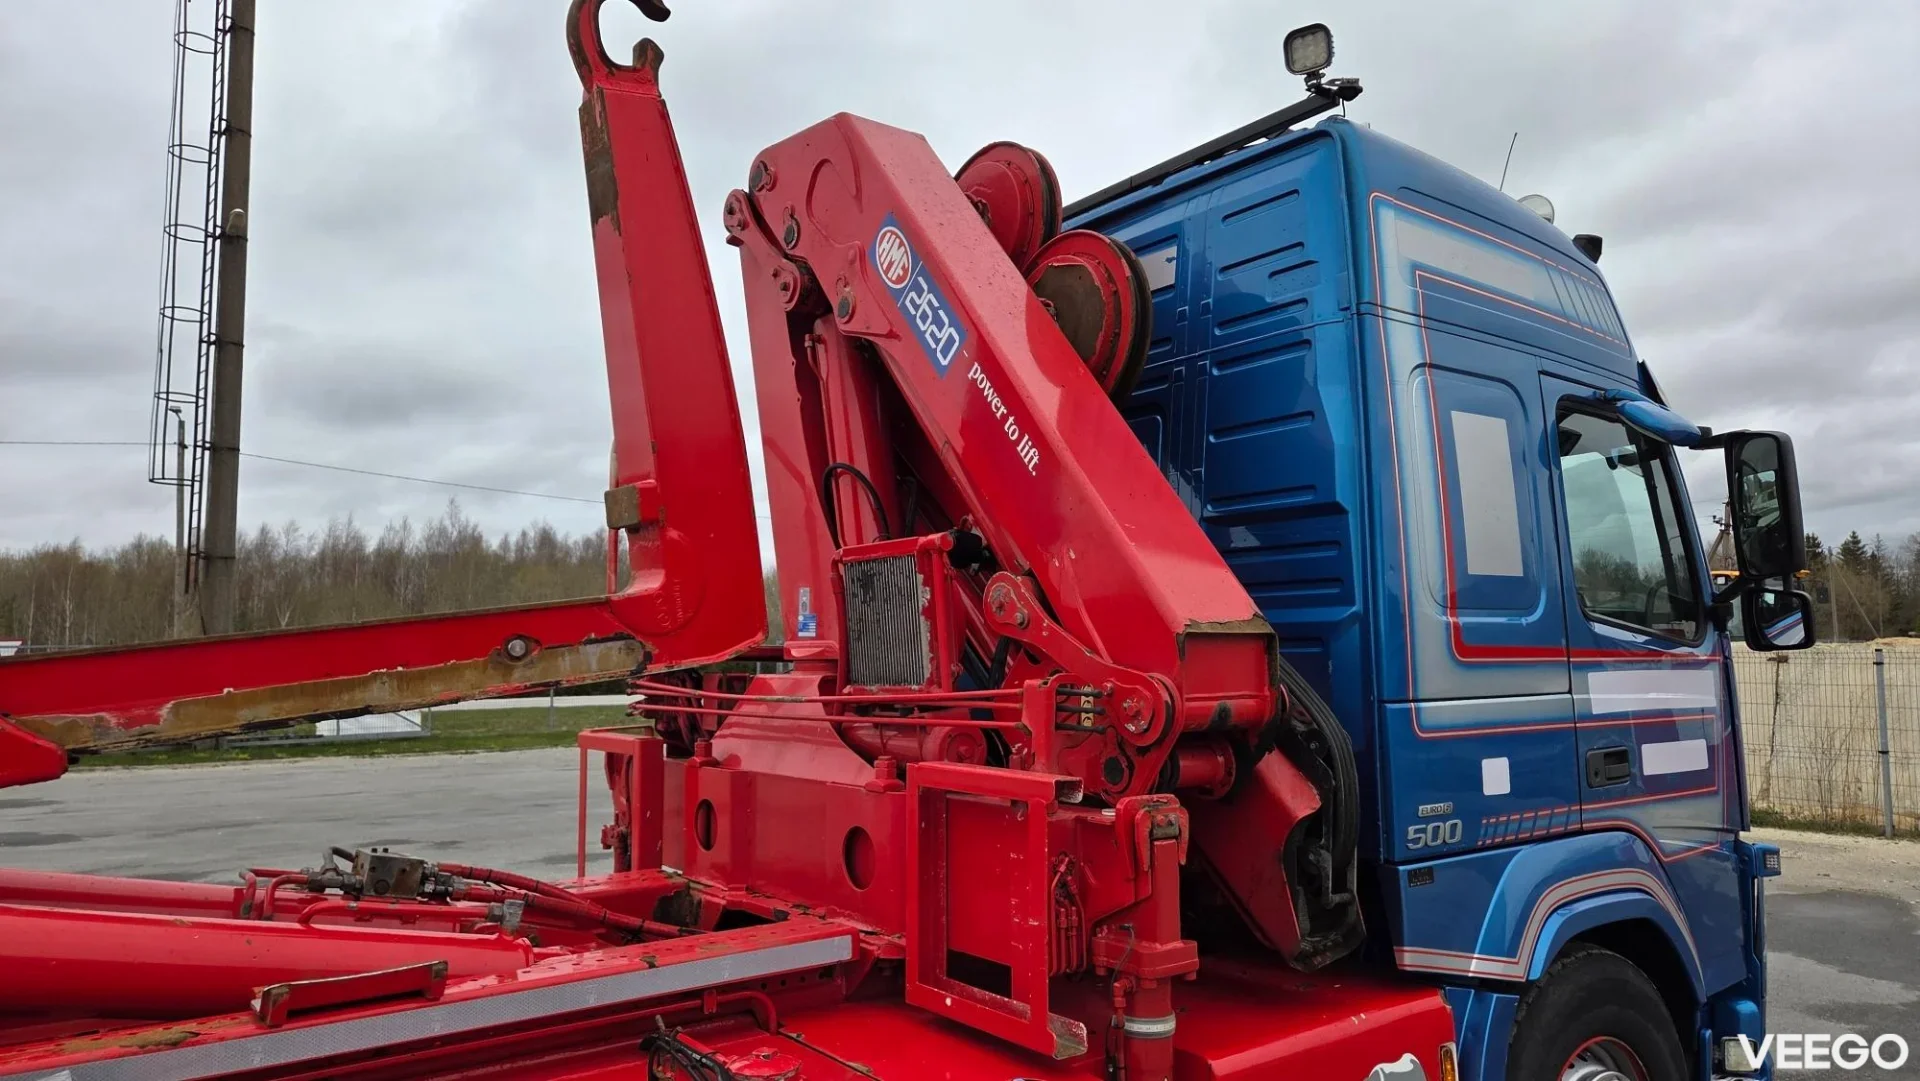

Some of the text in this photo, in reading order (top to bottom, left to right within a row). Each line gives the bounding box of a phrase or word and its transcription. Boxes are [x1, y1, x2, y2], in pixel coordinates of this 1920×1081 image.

[879, 232, 908, 281] HMF
[905, 276, 960, 366] 2620
[967, 361, 1007, 420] power
[1004, 415, 1020, 441] to
[1016, 433, 1040, 477] lift.
[1407, 819, 1463, 850] 500
